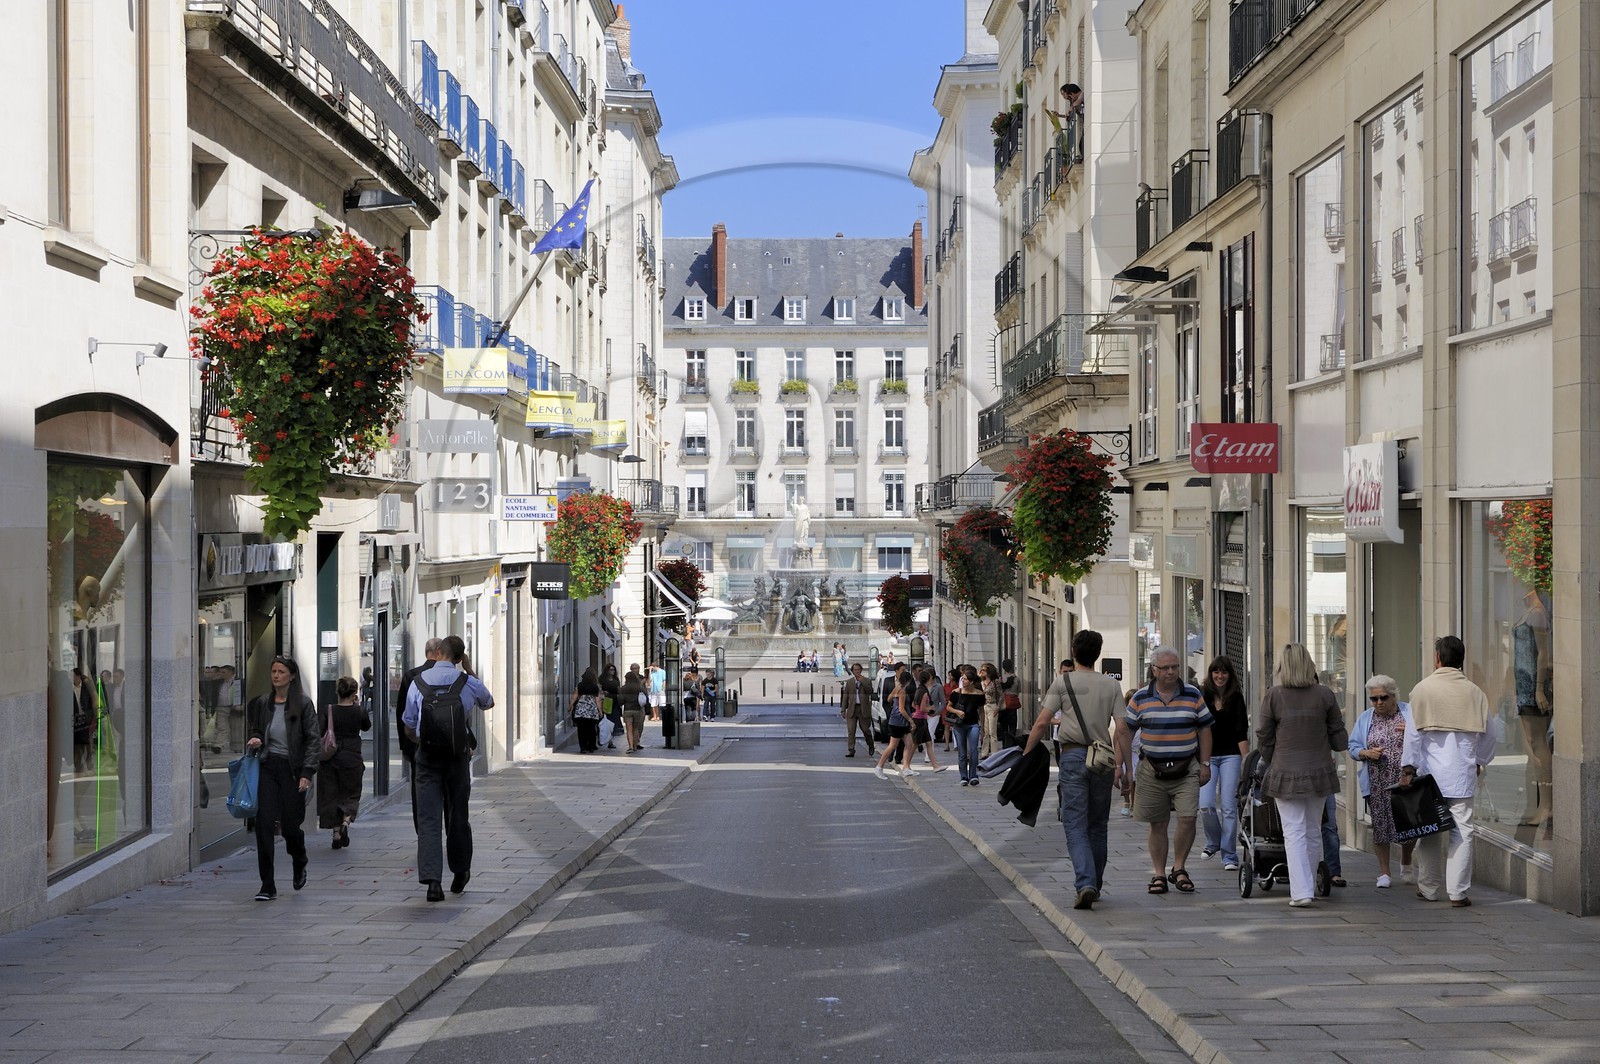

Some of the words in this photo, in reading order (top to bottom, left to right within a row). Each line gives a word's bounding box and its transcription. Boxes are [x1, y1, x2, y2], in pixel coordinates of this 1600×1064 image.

[446, 369, 505, 379] ENACOM
[1194, 433, 1275, 458] Etam
[1394, 829, 1417, 842] FATHER
[1417, 828, 1422, 836] &
[1421, 822, 1439, 835] SONS
